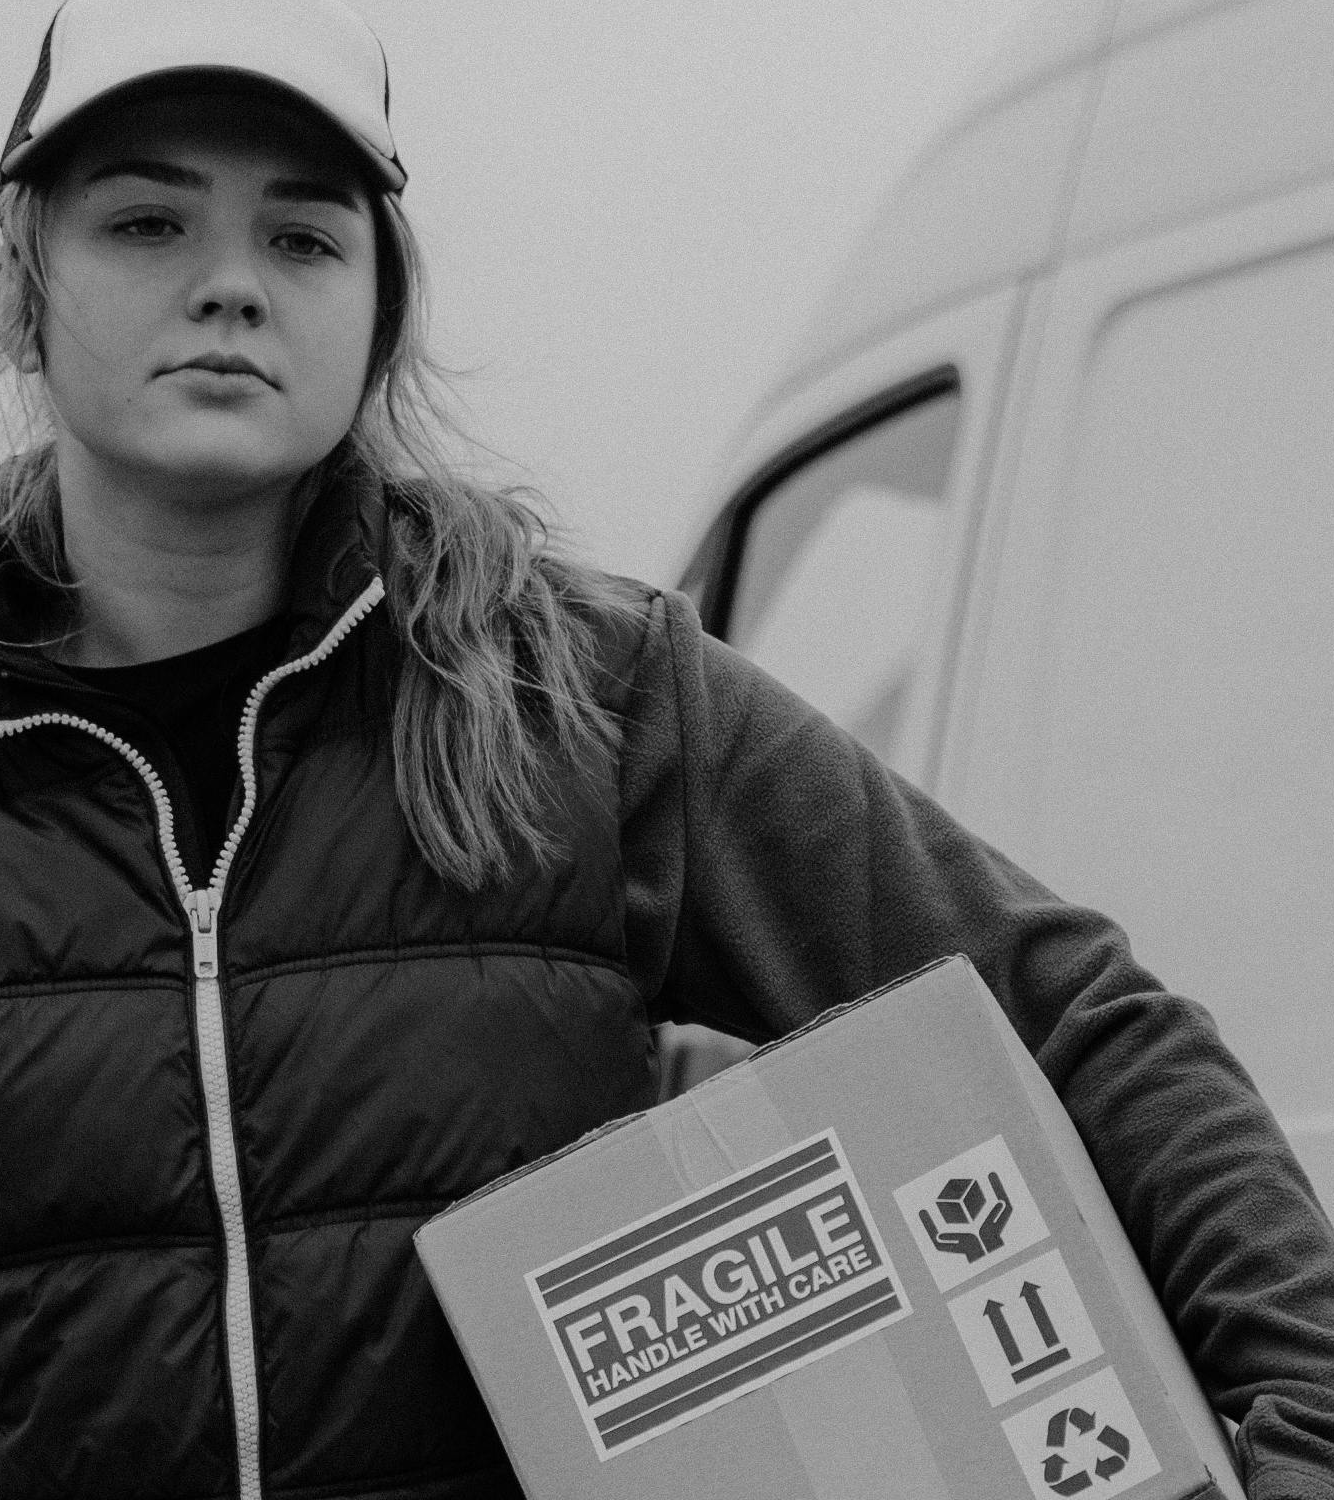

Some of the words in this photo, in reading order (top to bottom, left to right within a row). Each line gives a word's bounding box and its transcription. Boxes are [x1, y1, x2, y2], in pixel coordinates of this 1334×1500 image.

[565, 1195, 862, 1373] FRAGILE
[586, 1323, 709, 1398] HANDLE
[708, 1286, 786, 1337] WITH
[788, 1244, 873, 1301] CARE
